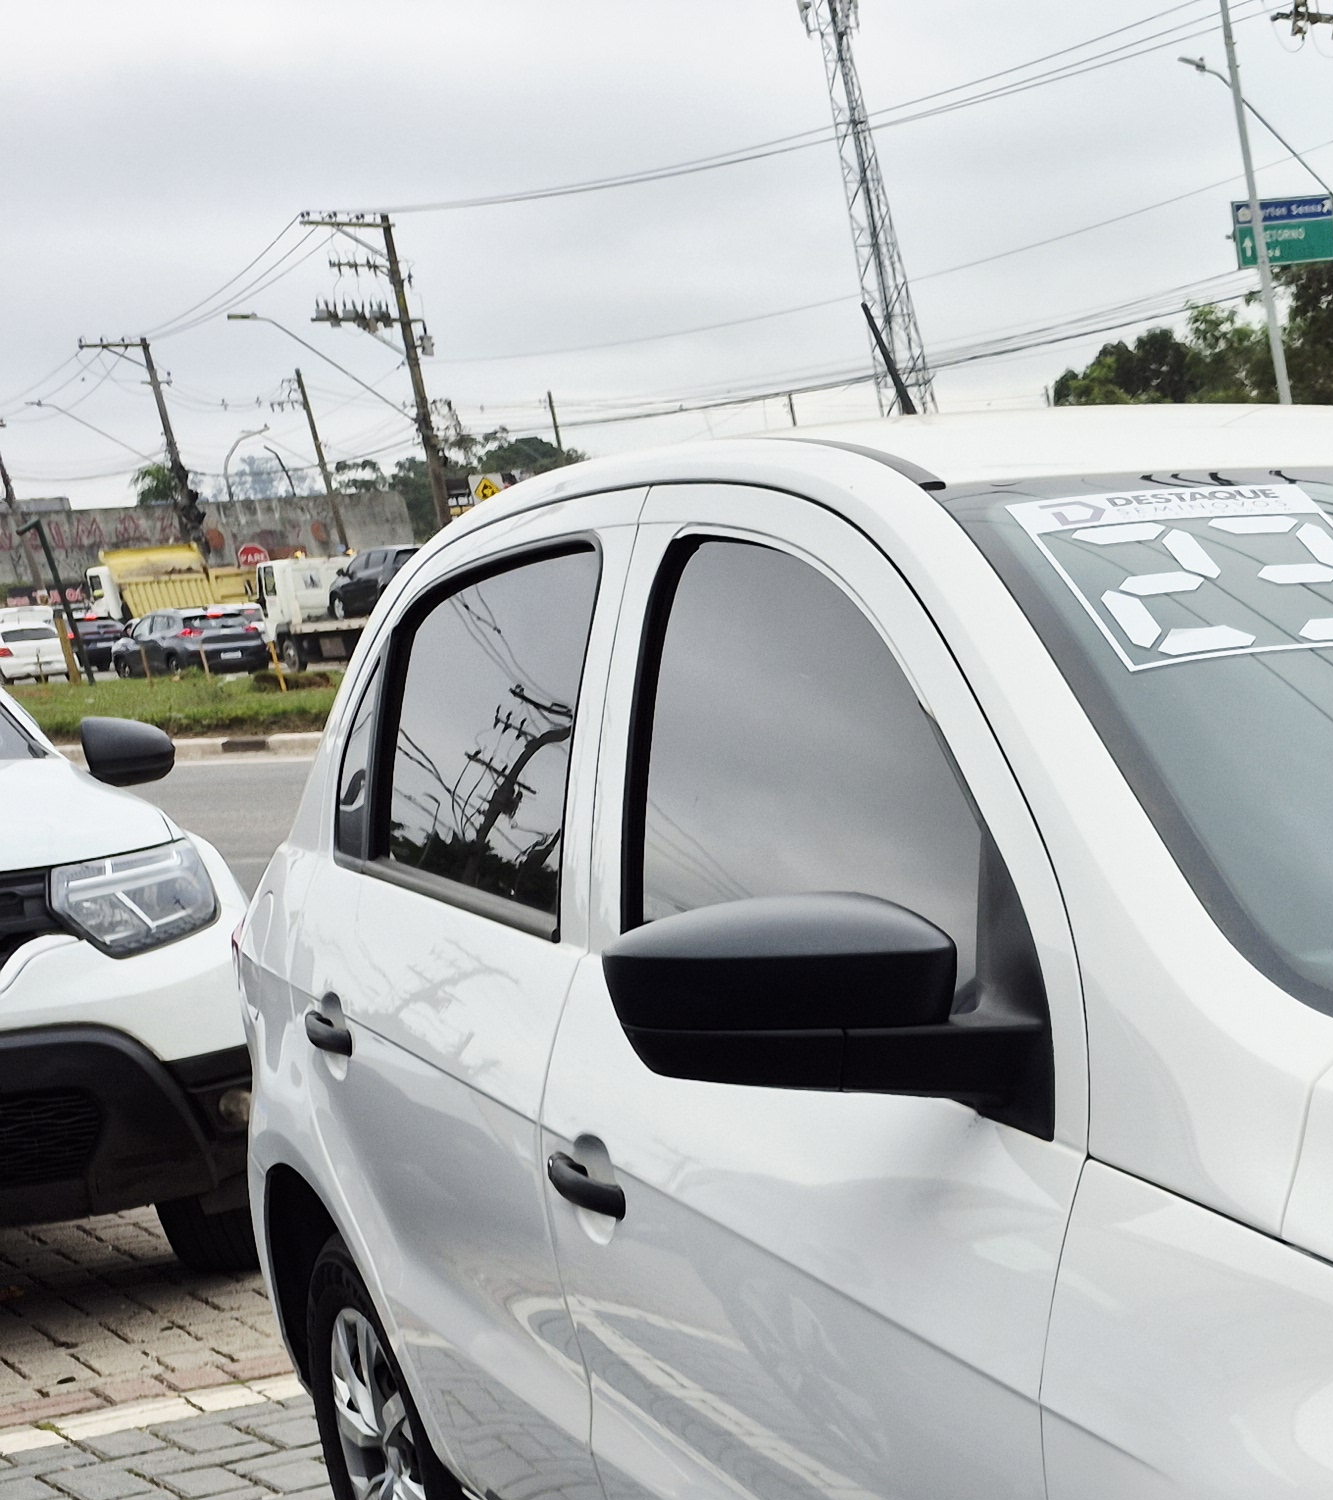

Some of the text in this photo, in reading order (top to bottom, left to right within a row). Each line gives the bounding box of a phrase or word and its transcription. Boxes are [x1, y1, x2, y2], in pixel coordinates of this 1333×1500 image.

[1264, 228, 1305, 241] ETORNO
[1105, 488, 1280, 508] DESTAQUE
[1115, 499, 1288, 516] SEMINOVOS
